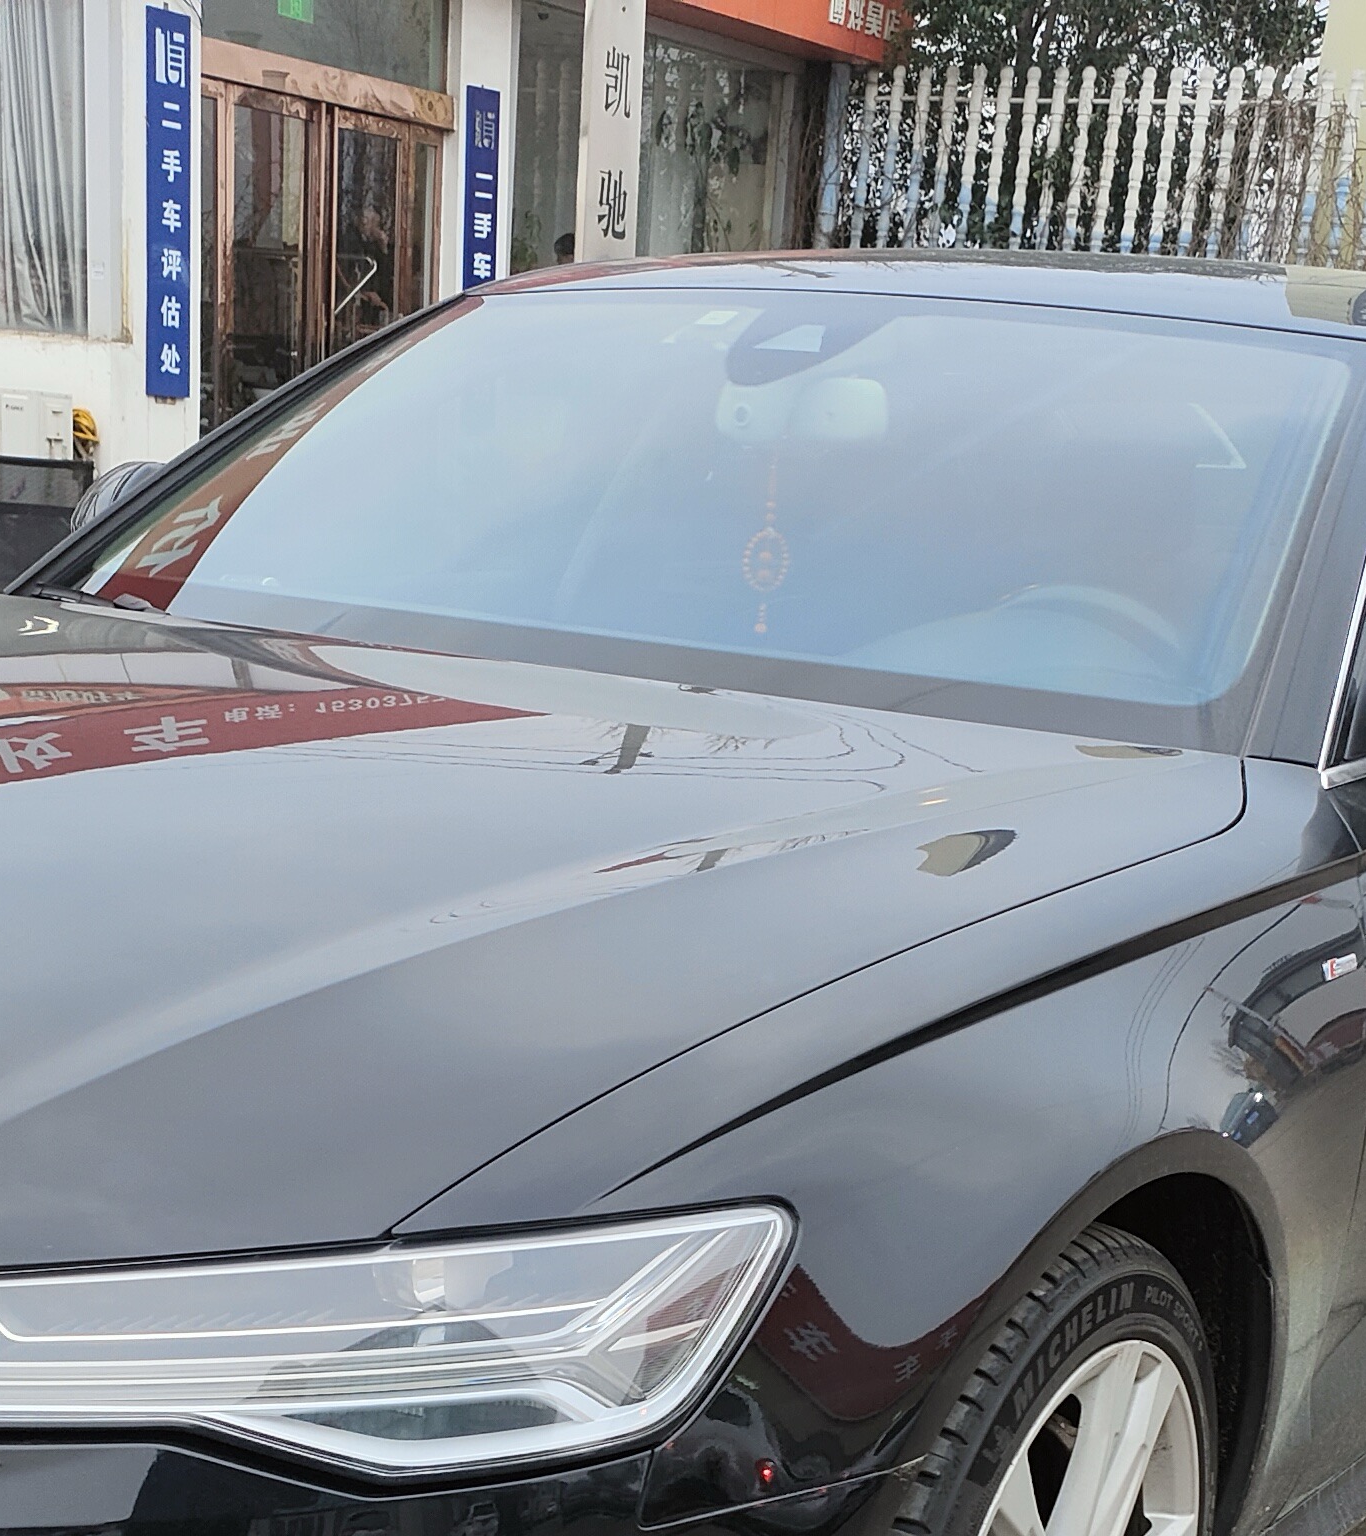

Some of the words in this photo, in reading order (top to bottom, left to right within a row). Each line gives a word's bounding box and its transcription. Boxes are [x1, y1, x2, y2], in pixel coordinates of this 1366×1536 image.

[473, 172, 494, 280] 二手车
[598, 46, 631, 241] 凯驰
[160, 102, 183, 375] 二手车评估处
[1014, 1282, 1135, 1423] MICHELIN
[1145, 1285, 1174, 1309] PILOT
